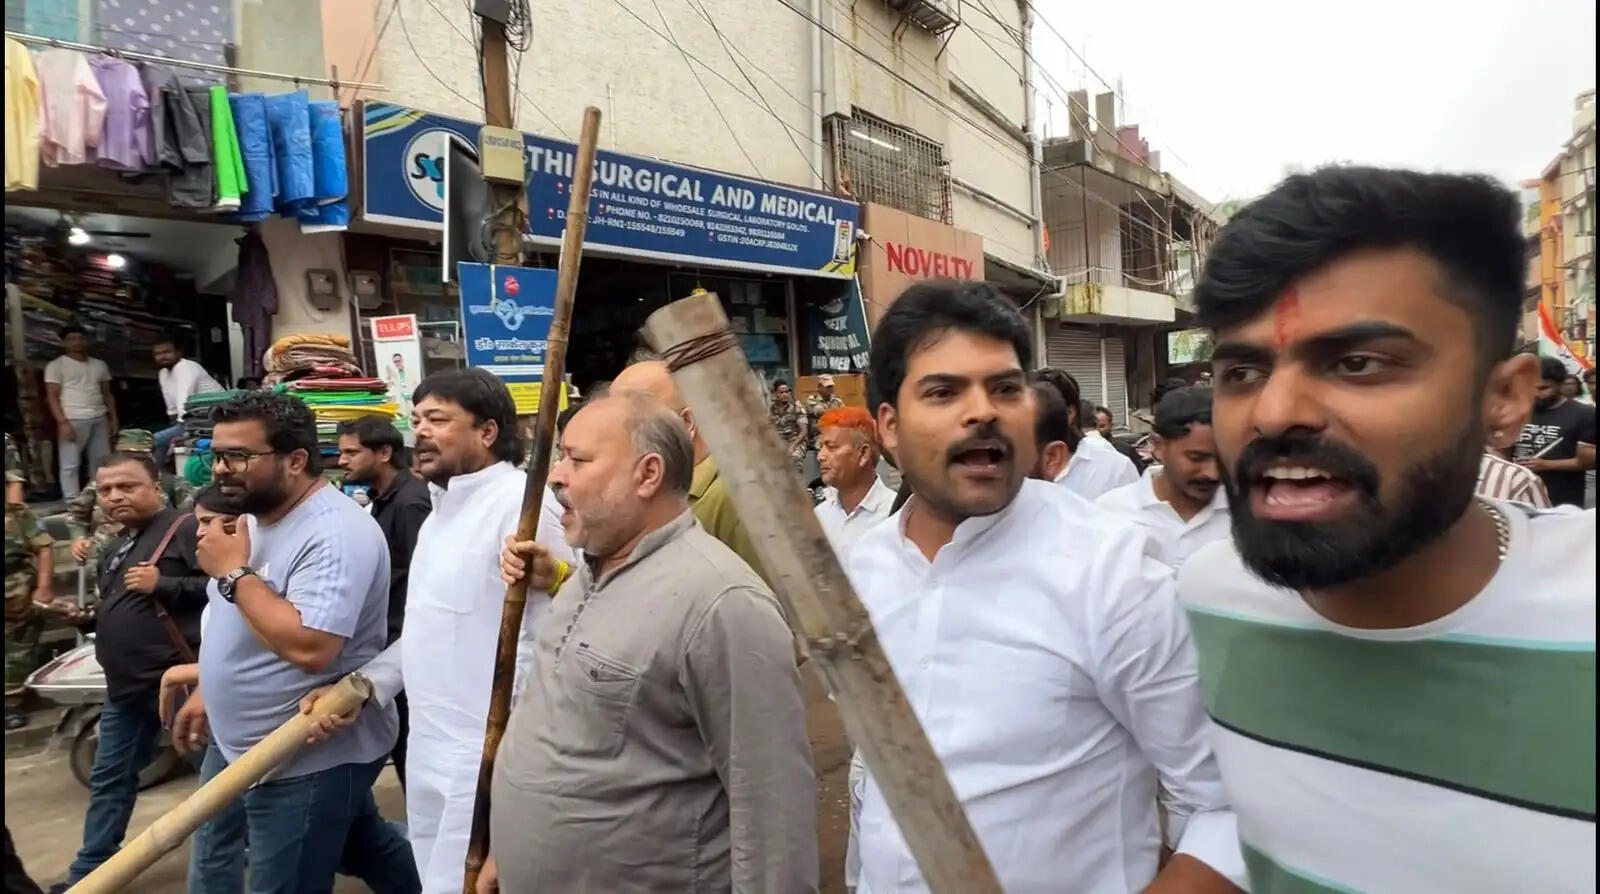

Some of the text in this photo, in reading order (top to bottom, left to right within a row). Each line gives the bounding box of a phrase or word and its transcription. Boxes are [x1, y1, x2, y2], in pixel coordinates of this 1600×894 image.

[599, 190, 609, 200] IN
[610, 192, 626, 203] ALL
[628, 195, 649, 207] KIND
[650, 198, 662, 209] OF
[605, 205, 637, 219] PHONE
[710, 184, 756, 210] AND
[760, 192, 836, 226] MEDICAL
[886, 241, 974, 281] NOVELTY
